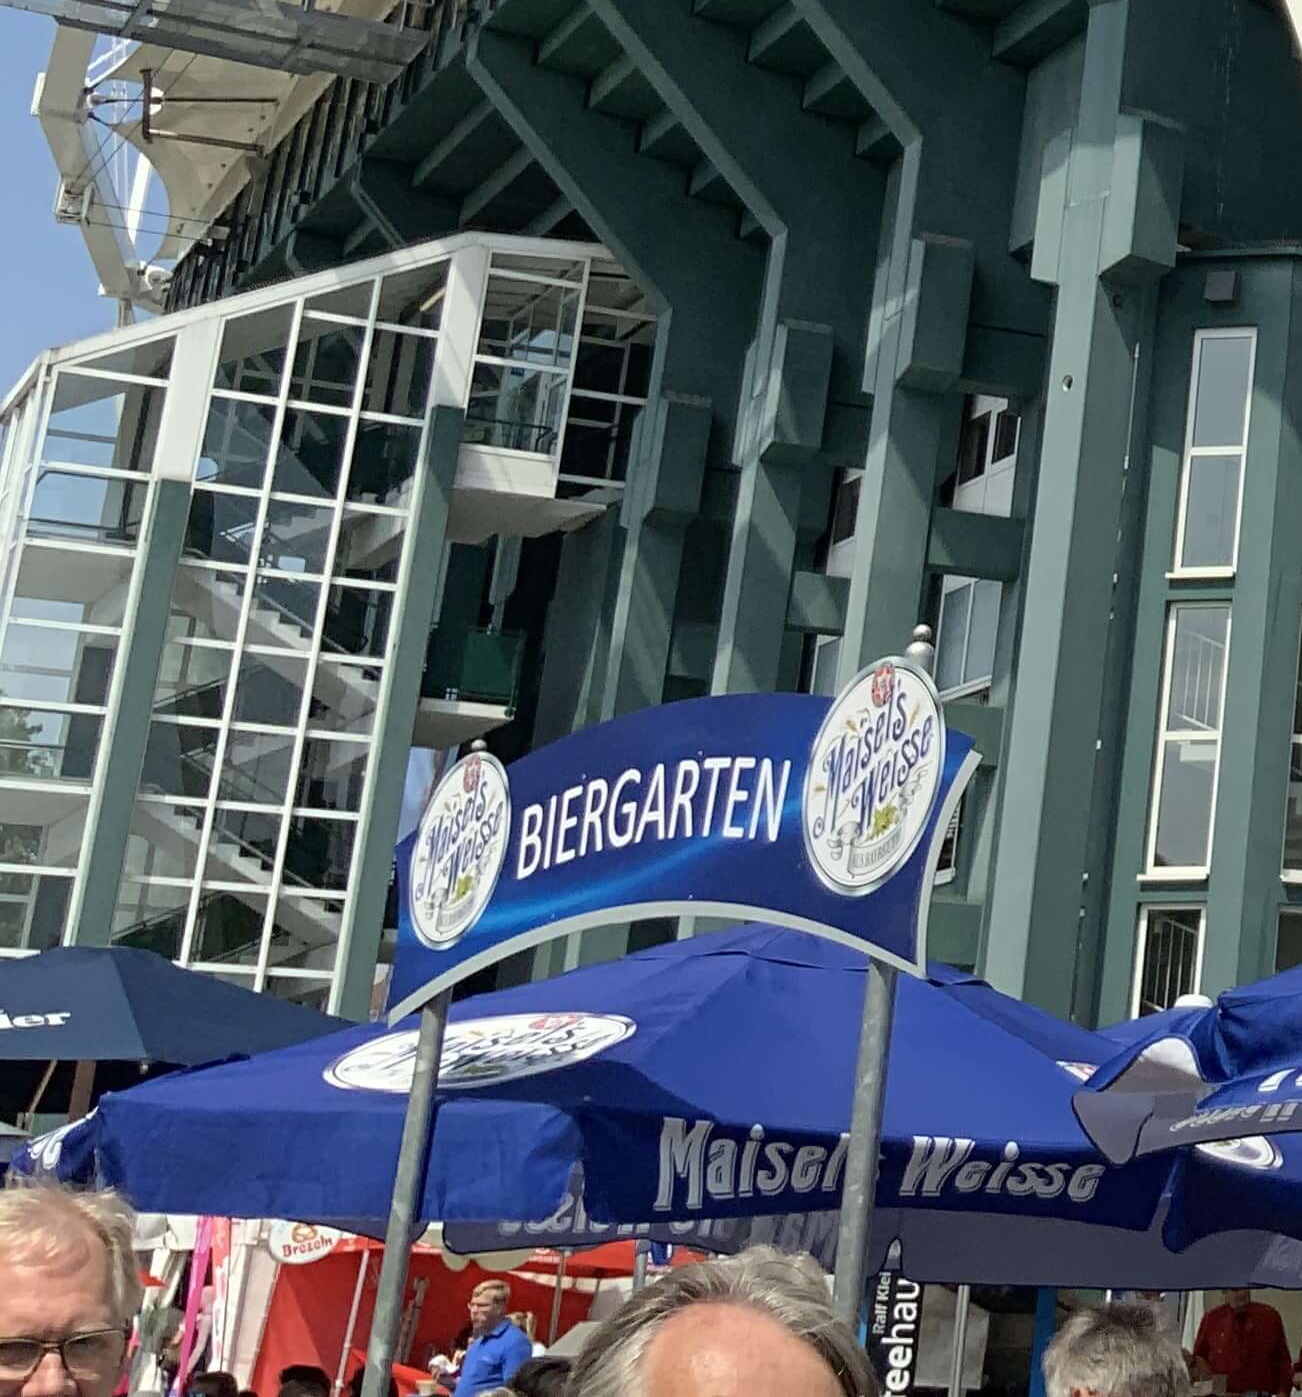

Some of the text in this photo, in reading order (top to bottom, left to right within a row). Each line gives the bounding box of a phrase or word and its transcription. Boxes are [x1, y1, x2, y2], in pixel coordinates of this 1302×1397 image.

[813, 678, 907, 839] Maisel's
[851, 714, 933, 838] Weisse
[517, 757, 792, 881] BIERGARTEN
[899, 1135, 1106, 1202] Weisse
[282, 1234, 334, 1257] Brezeln
[872, 1303, 889, 1335] Ralf
